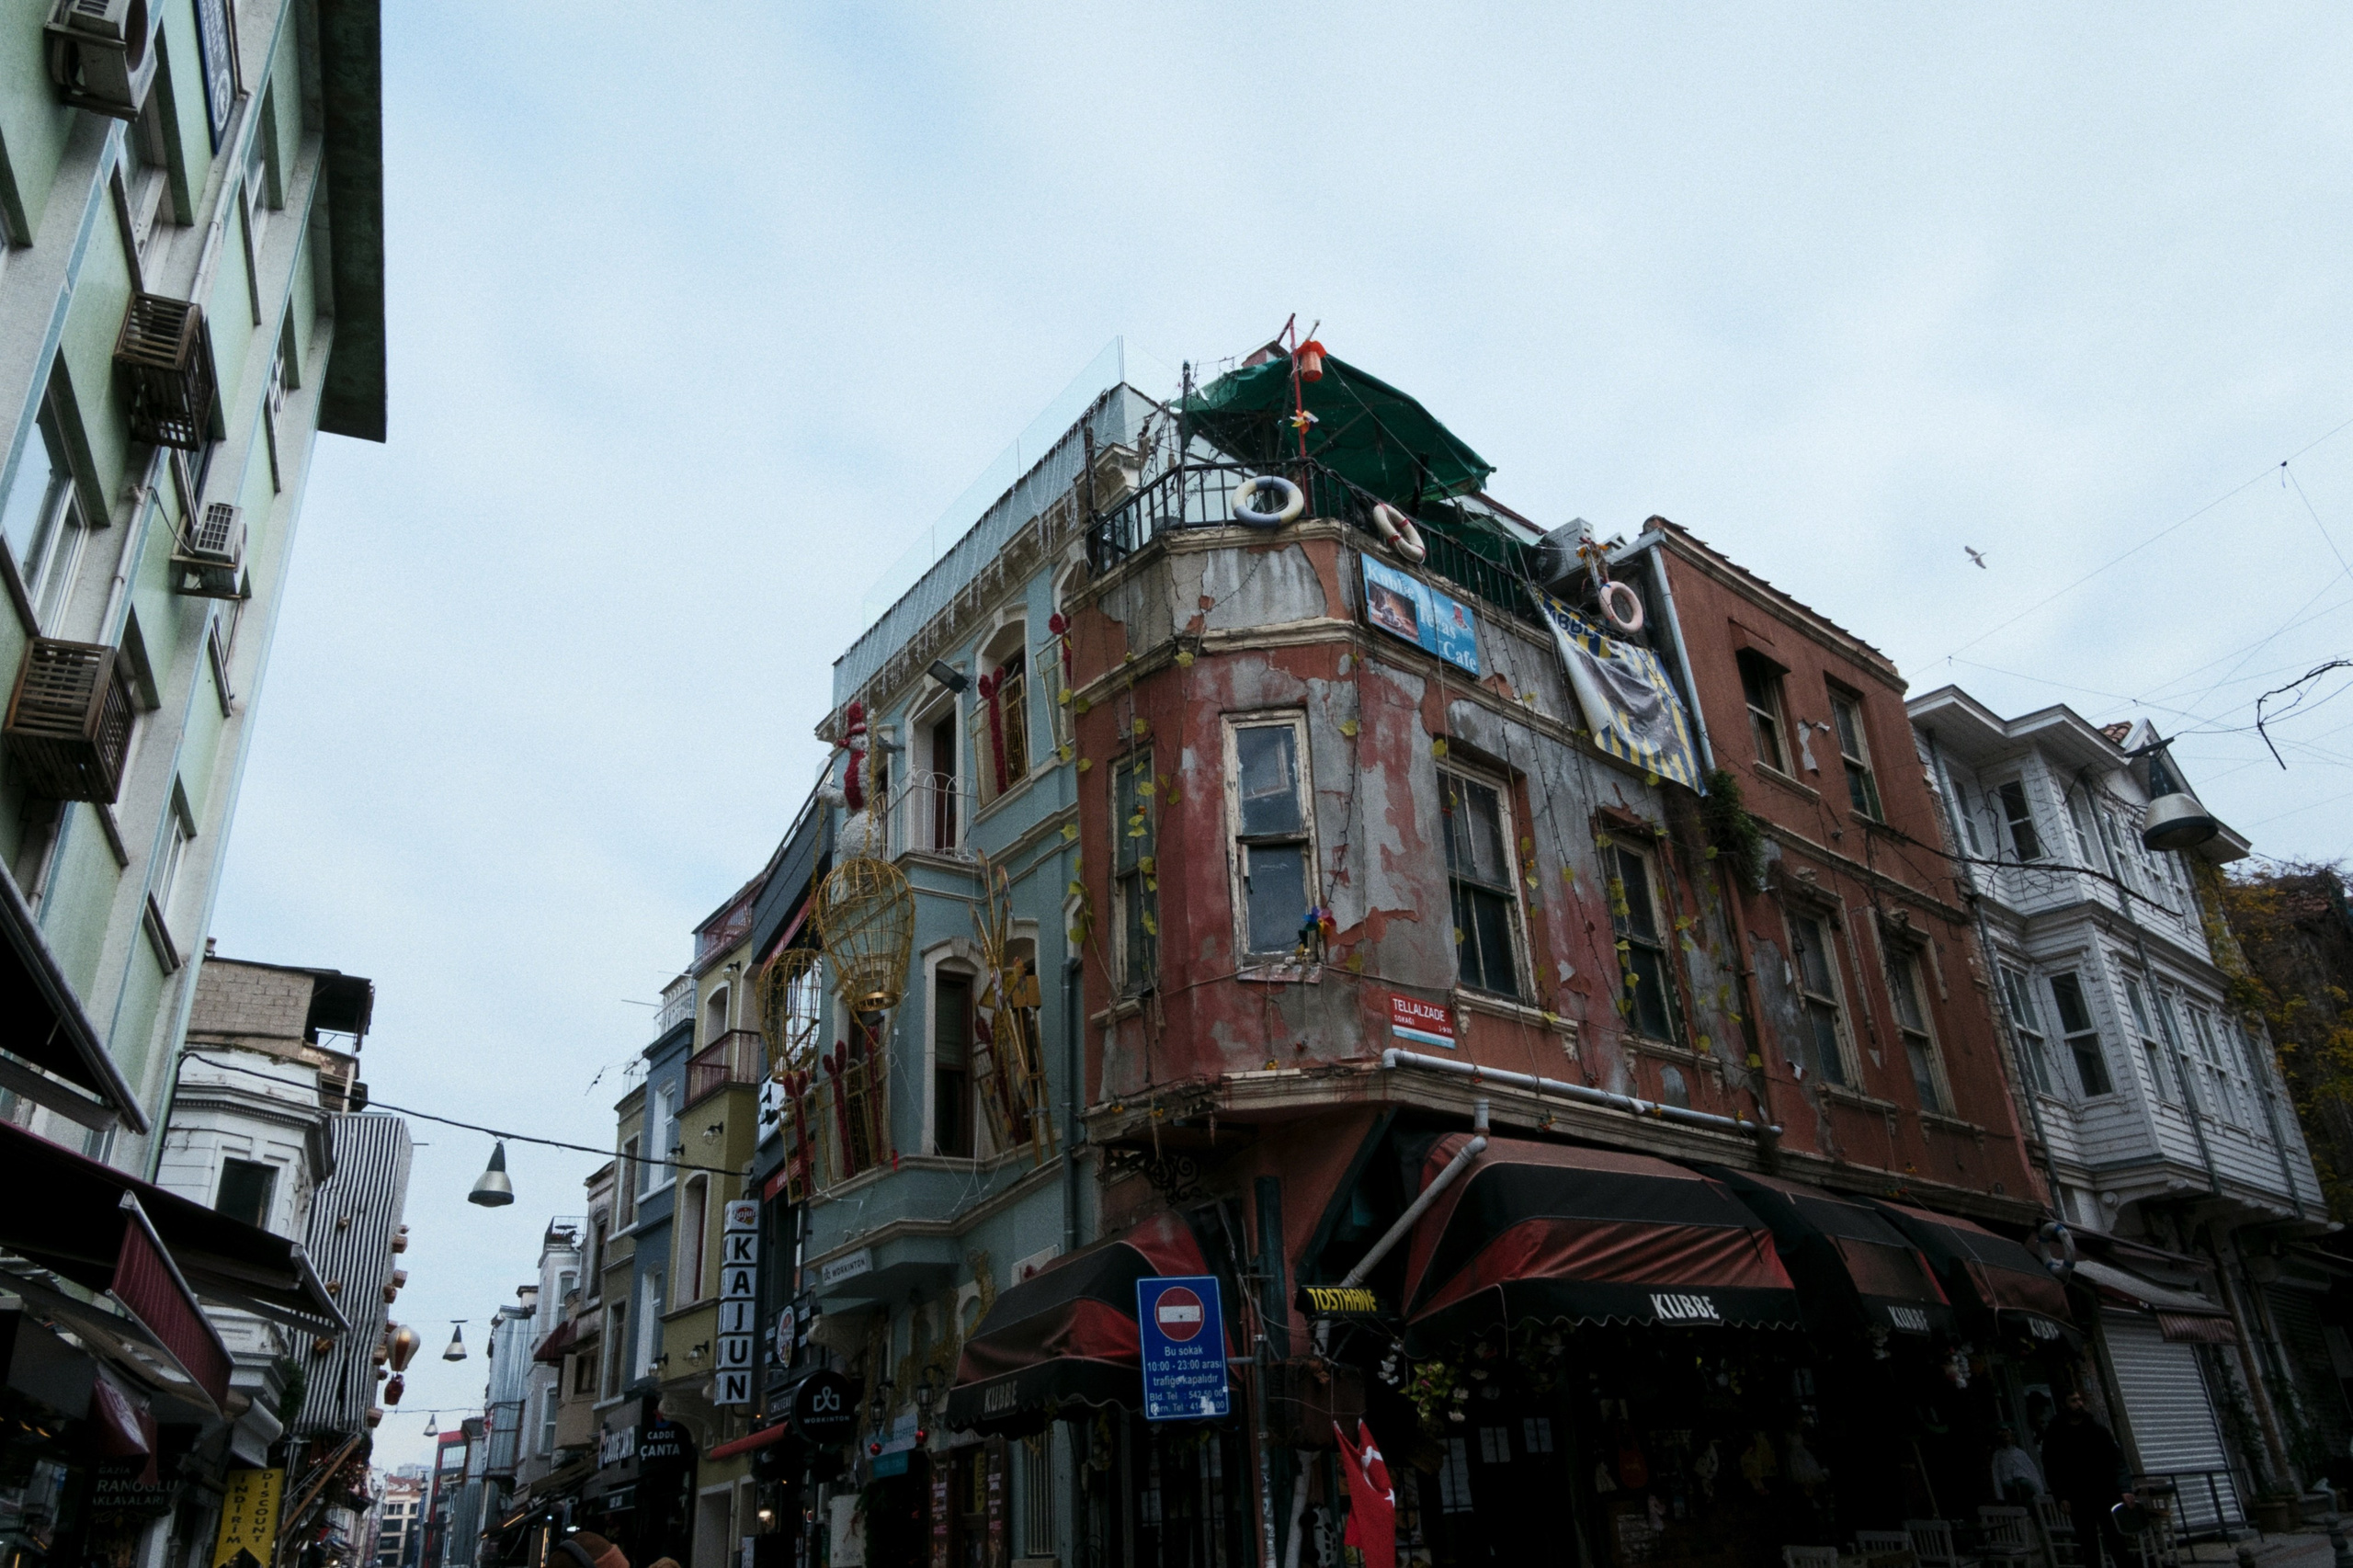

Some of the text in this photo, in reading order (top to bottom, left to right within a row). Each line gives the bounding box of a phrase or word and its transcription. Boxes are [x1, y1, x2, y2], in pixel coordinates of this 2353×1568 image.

[1442, 640, 1477, 671] Cafe
[1392, 998, 1446, 1022] TELLALZADE
[1393, 1014, 1415, 1026] SOKAĞI
[832, 1257, 866, 1277] WORKINTON
[1306, 1287, 1378, 1312] TOSTHANE
[1648, 1292, 1721, 1320] KUBBE
[726, 1236, 753, 1400] KAJUN
[1887, 1304, 1931, 1332] KUBBE
[1164, 1344, 1203, 1357] Bu sokak
[1147, 1360, 1170, 1372] 10:00
[1176, 1359, 1199, 1370] 23:00
[1201, 1358, 1222, 1369] arası
[1181, 1373, 1219, 1388] kapalıdır
[983, 1379, 1018, 1414] KUBBE
[1166, 1391, 1178, 1401] Tel
[1188, 1390, 1202, 1400] 542
[1213, 1388, 1223, 1398] 00
[1172, 1402, 1185, 1412] Tel
[1215, 1400, 1225, 1410] 00
[802, 1415, 850, 1425] WORKINTON
[646, 1429, 676, 1440] CADDE
[639, 1442, 681, 1461] ÇANTA
[252, 1472, 273, 1543] DISCOUNT
